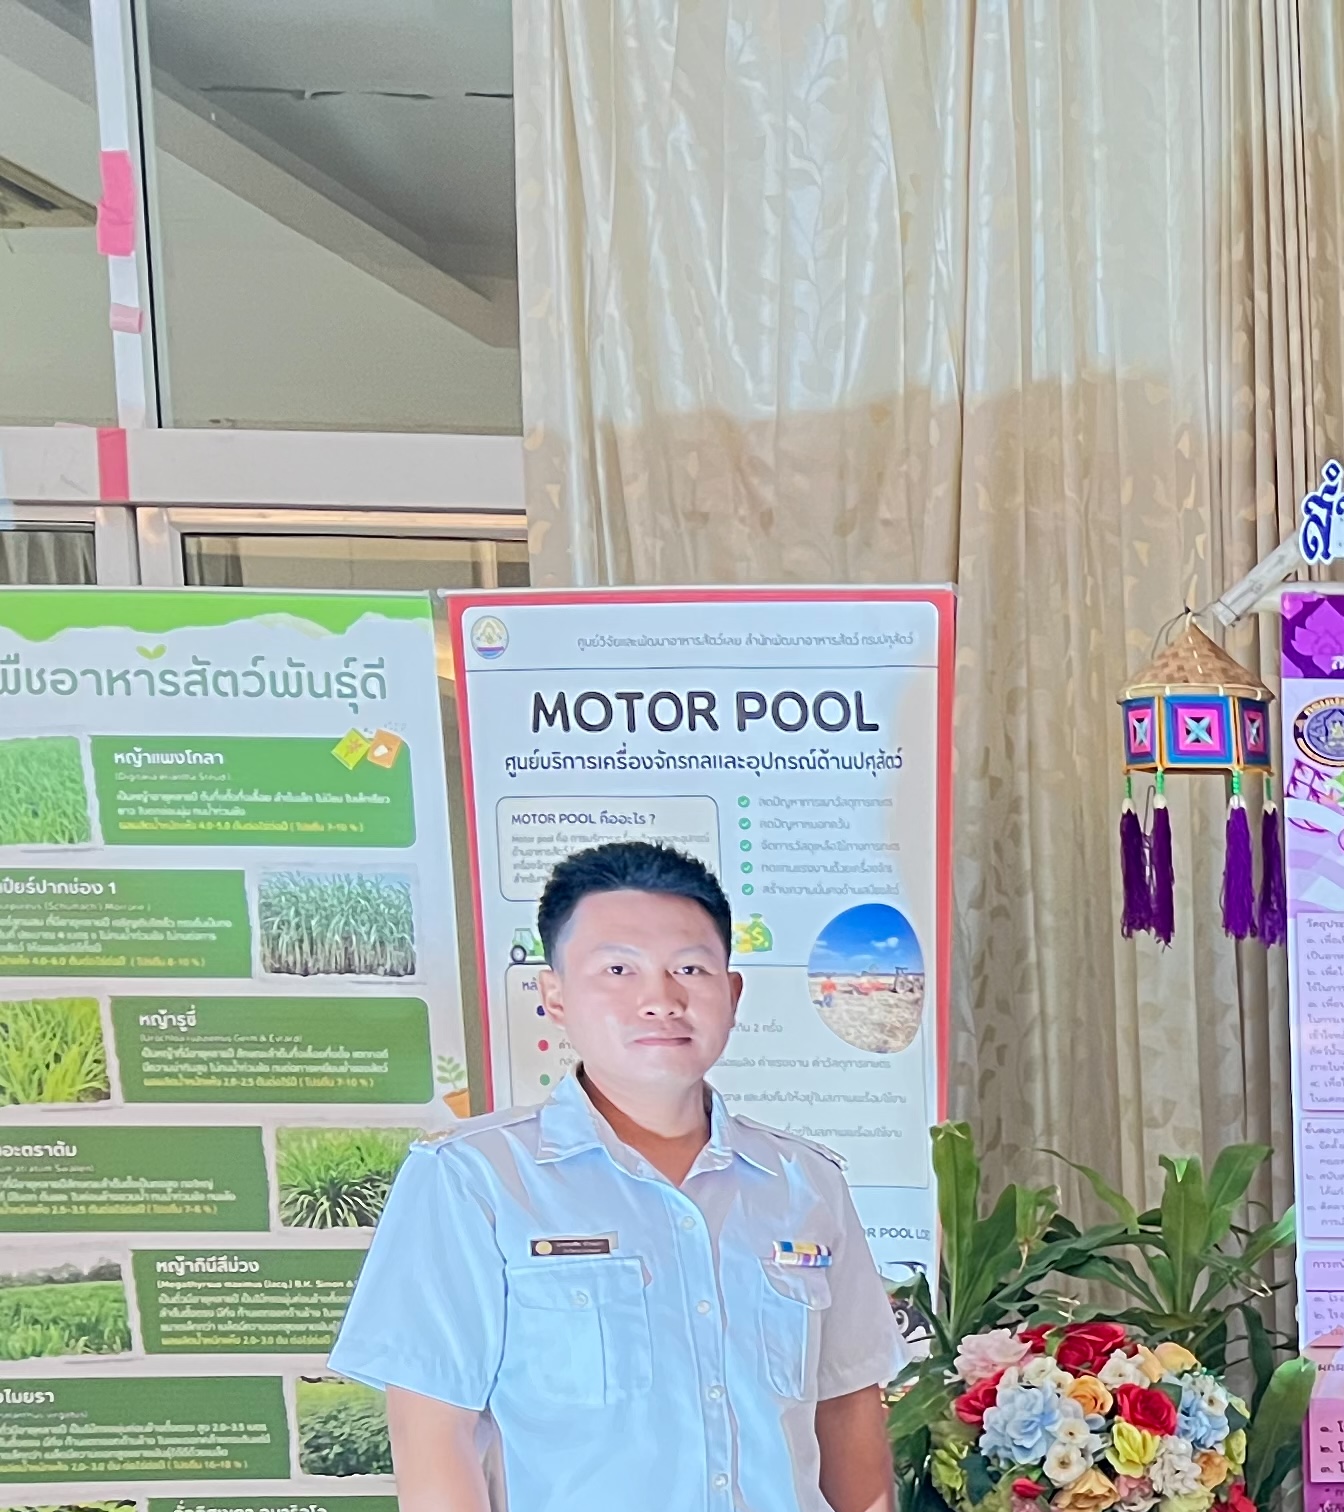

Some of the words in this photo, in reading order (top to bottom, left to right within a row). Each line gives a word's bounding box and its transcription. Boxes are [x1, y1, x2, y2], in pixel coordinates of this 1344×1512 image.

[532, 691, 718, 734] MOTOR
[736, 691, 879, 733] POOL
[114, 747, 224, 768] หญ้าแพงโกลา
[505, 743, 903, 778] ศูนย์บริการเครื่องจักรกลและอุปกรณ์ด้านปศุสัตว์
[511, 813, 556, 825] MOTOR
[559, 813, 596, 824] POOL
[600, 810, 646, 825] คืออะไร
[649, 813, 656, 825] ?
[880, 1228, 914, 1238] POOL
